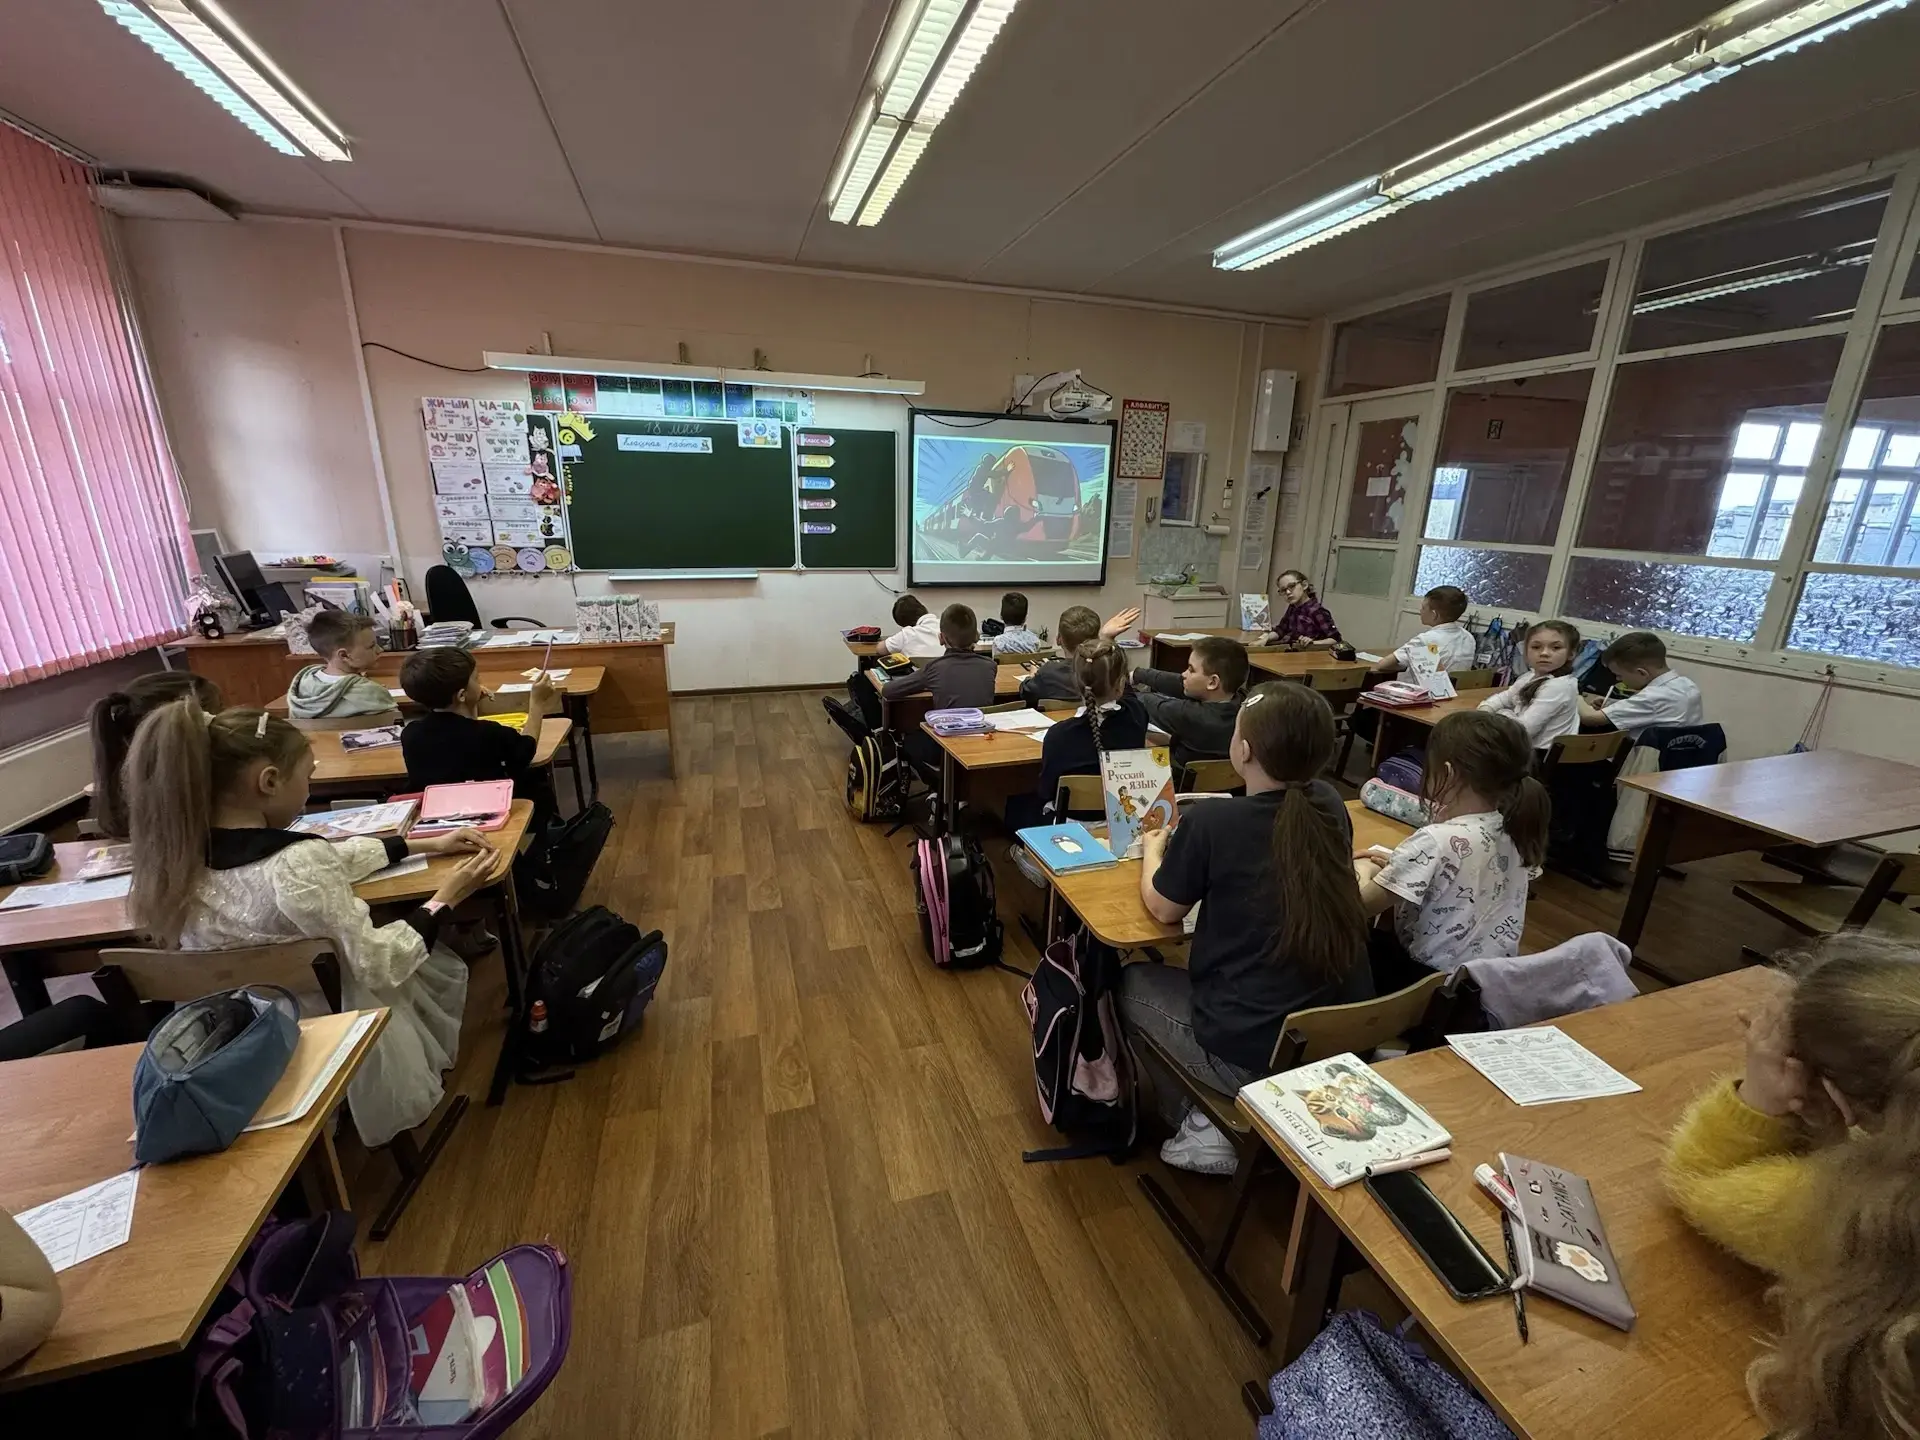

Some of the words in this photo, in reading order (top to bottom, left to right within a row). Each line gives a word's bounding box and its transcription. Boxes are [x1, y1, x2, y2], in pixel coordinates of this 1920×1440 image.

[426, 398, 469, 409] ЖИ-ШИ
[478, 400, 521, 411] ЧА-ЩА
[644, 422, 661, 435] 18
[668, 423, 704, 435] мая
[430, 432, 474, 443] ЧУ-ЩУ
[1107, 770, 1145, 782] Русский
[1490, 915, 1518, 940] LOVE
[1271, 1100, 1334, 1156] Дневник
